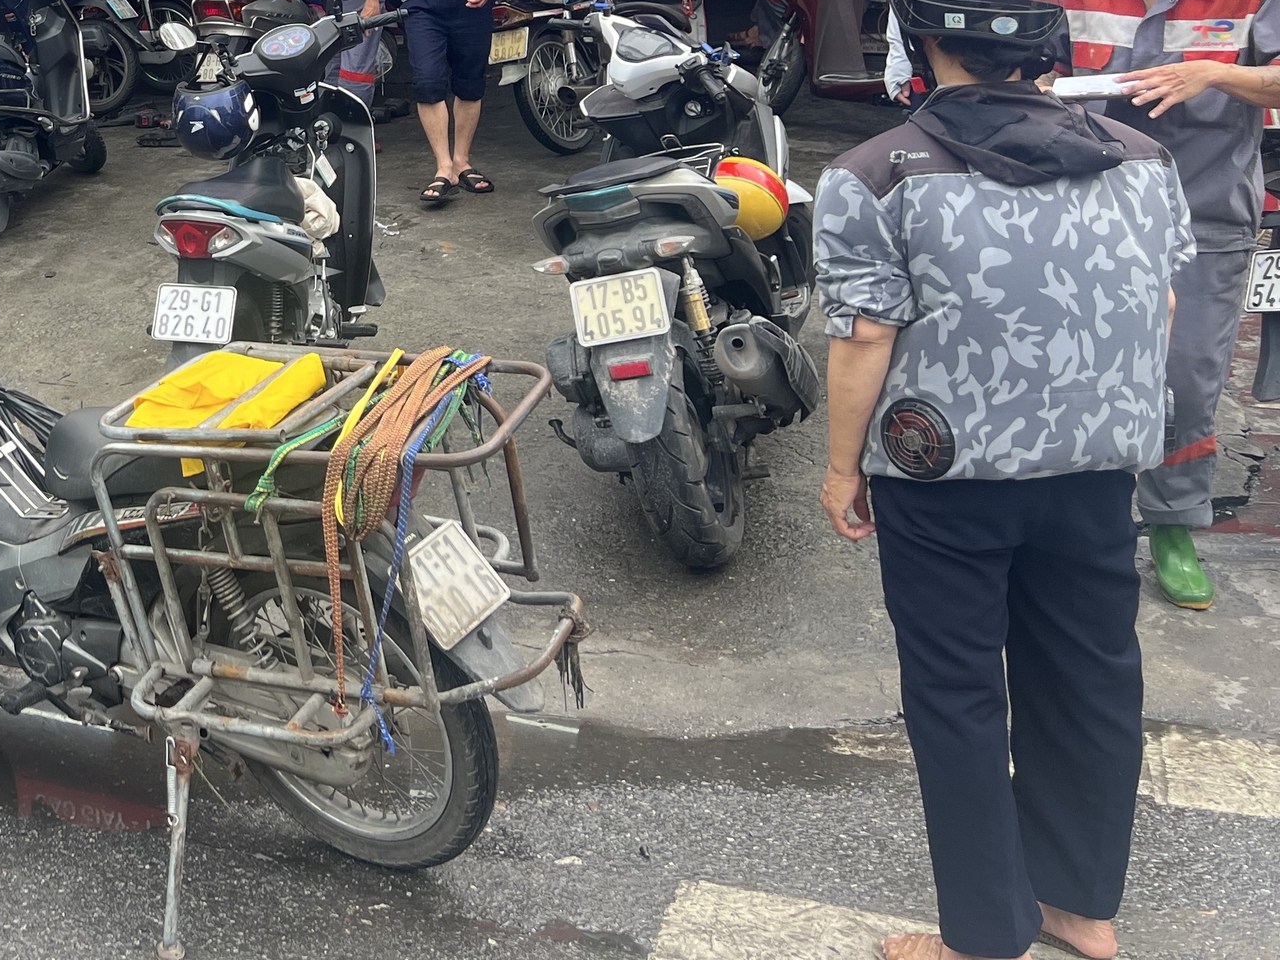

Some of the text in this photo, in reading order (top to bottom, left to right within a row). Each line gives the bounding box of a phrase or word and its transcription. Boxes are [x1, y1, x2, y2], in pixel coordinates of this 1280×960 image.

[167, 290, 222, 313] 29-G1
[586, 274, 648, 304] 17-B5
[157, 315, 227, 339] 826.40
[583, 310, 663, 342] 405.94
